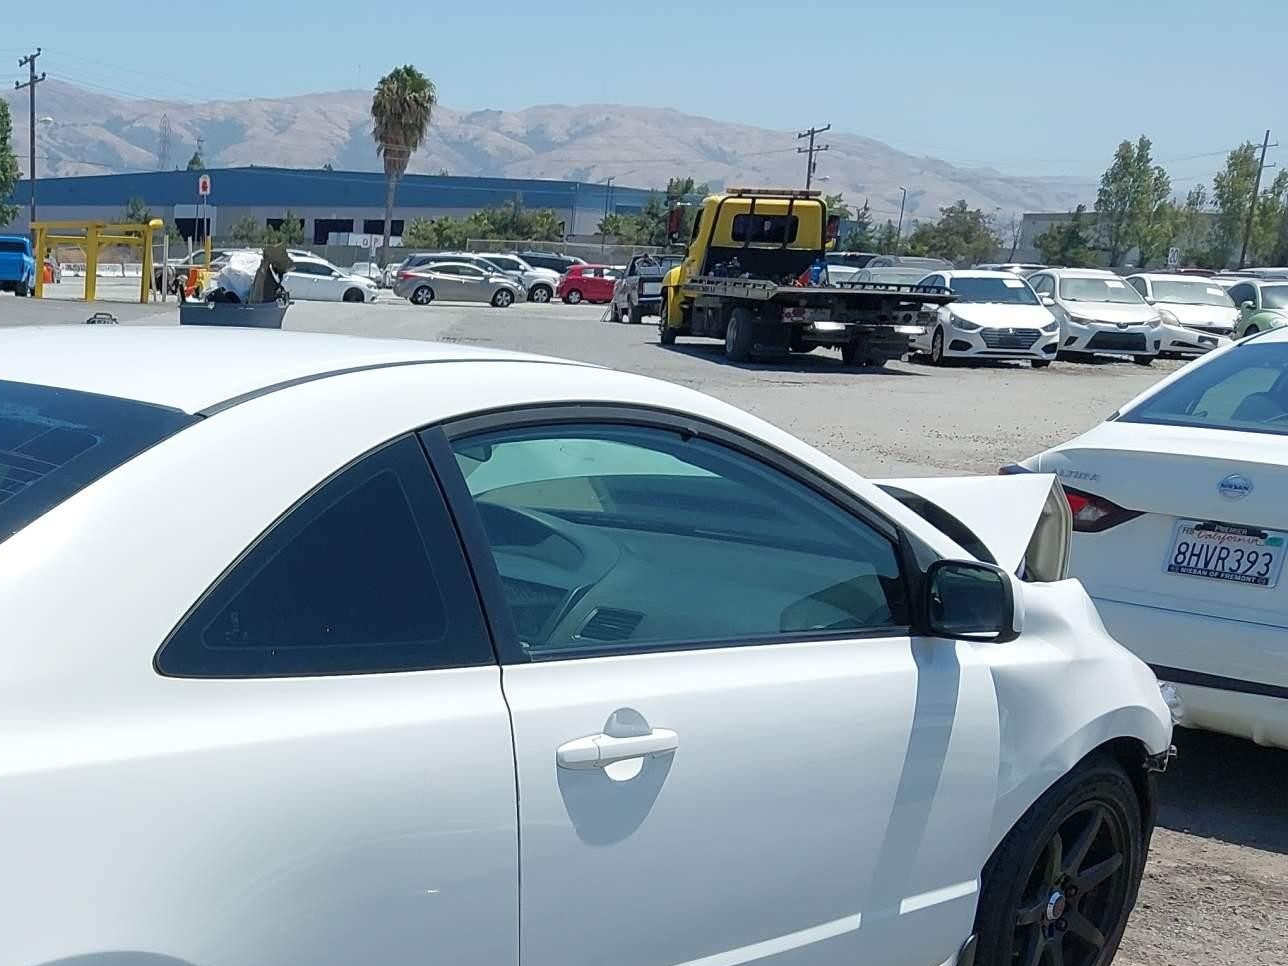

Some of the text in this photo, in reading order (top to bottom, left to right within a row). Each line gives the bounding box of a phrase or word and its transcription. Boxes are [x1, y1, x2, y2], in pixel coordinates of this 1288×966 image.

[1174, 541, 1273, 577] 8HVR393
[1180, 567, 1257, 584] NISSAN OF FREMONT
